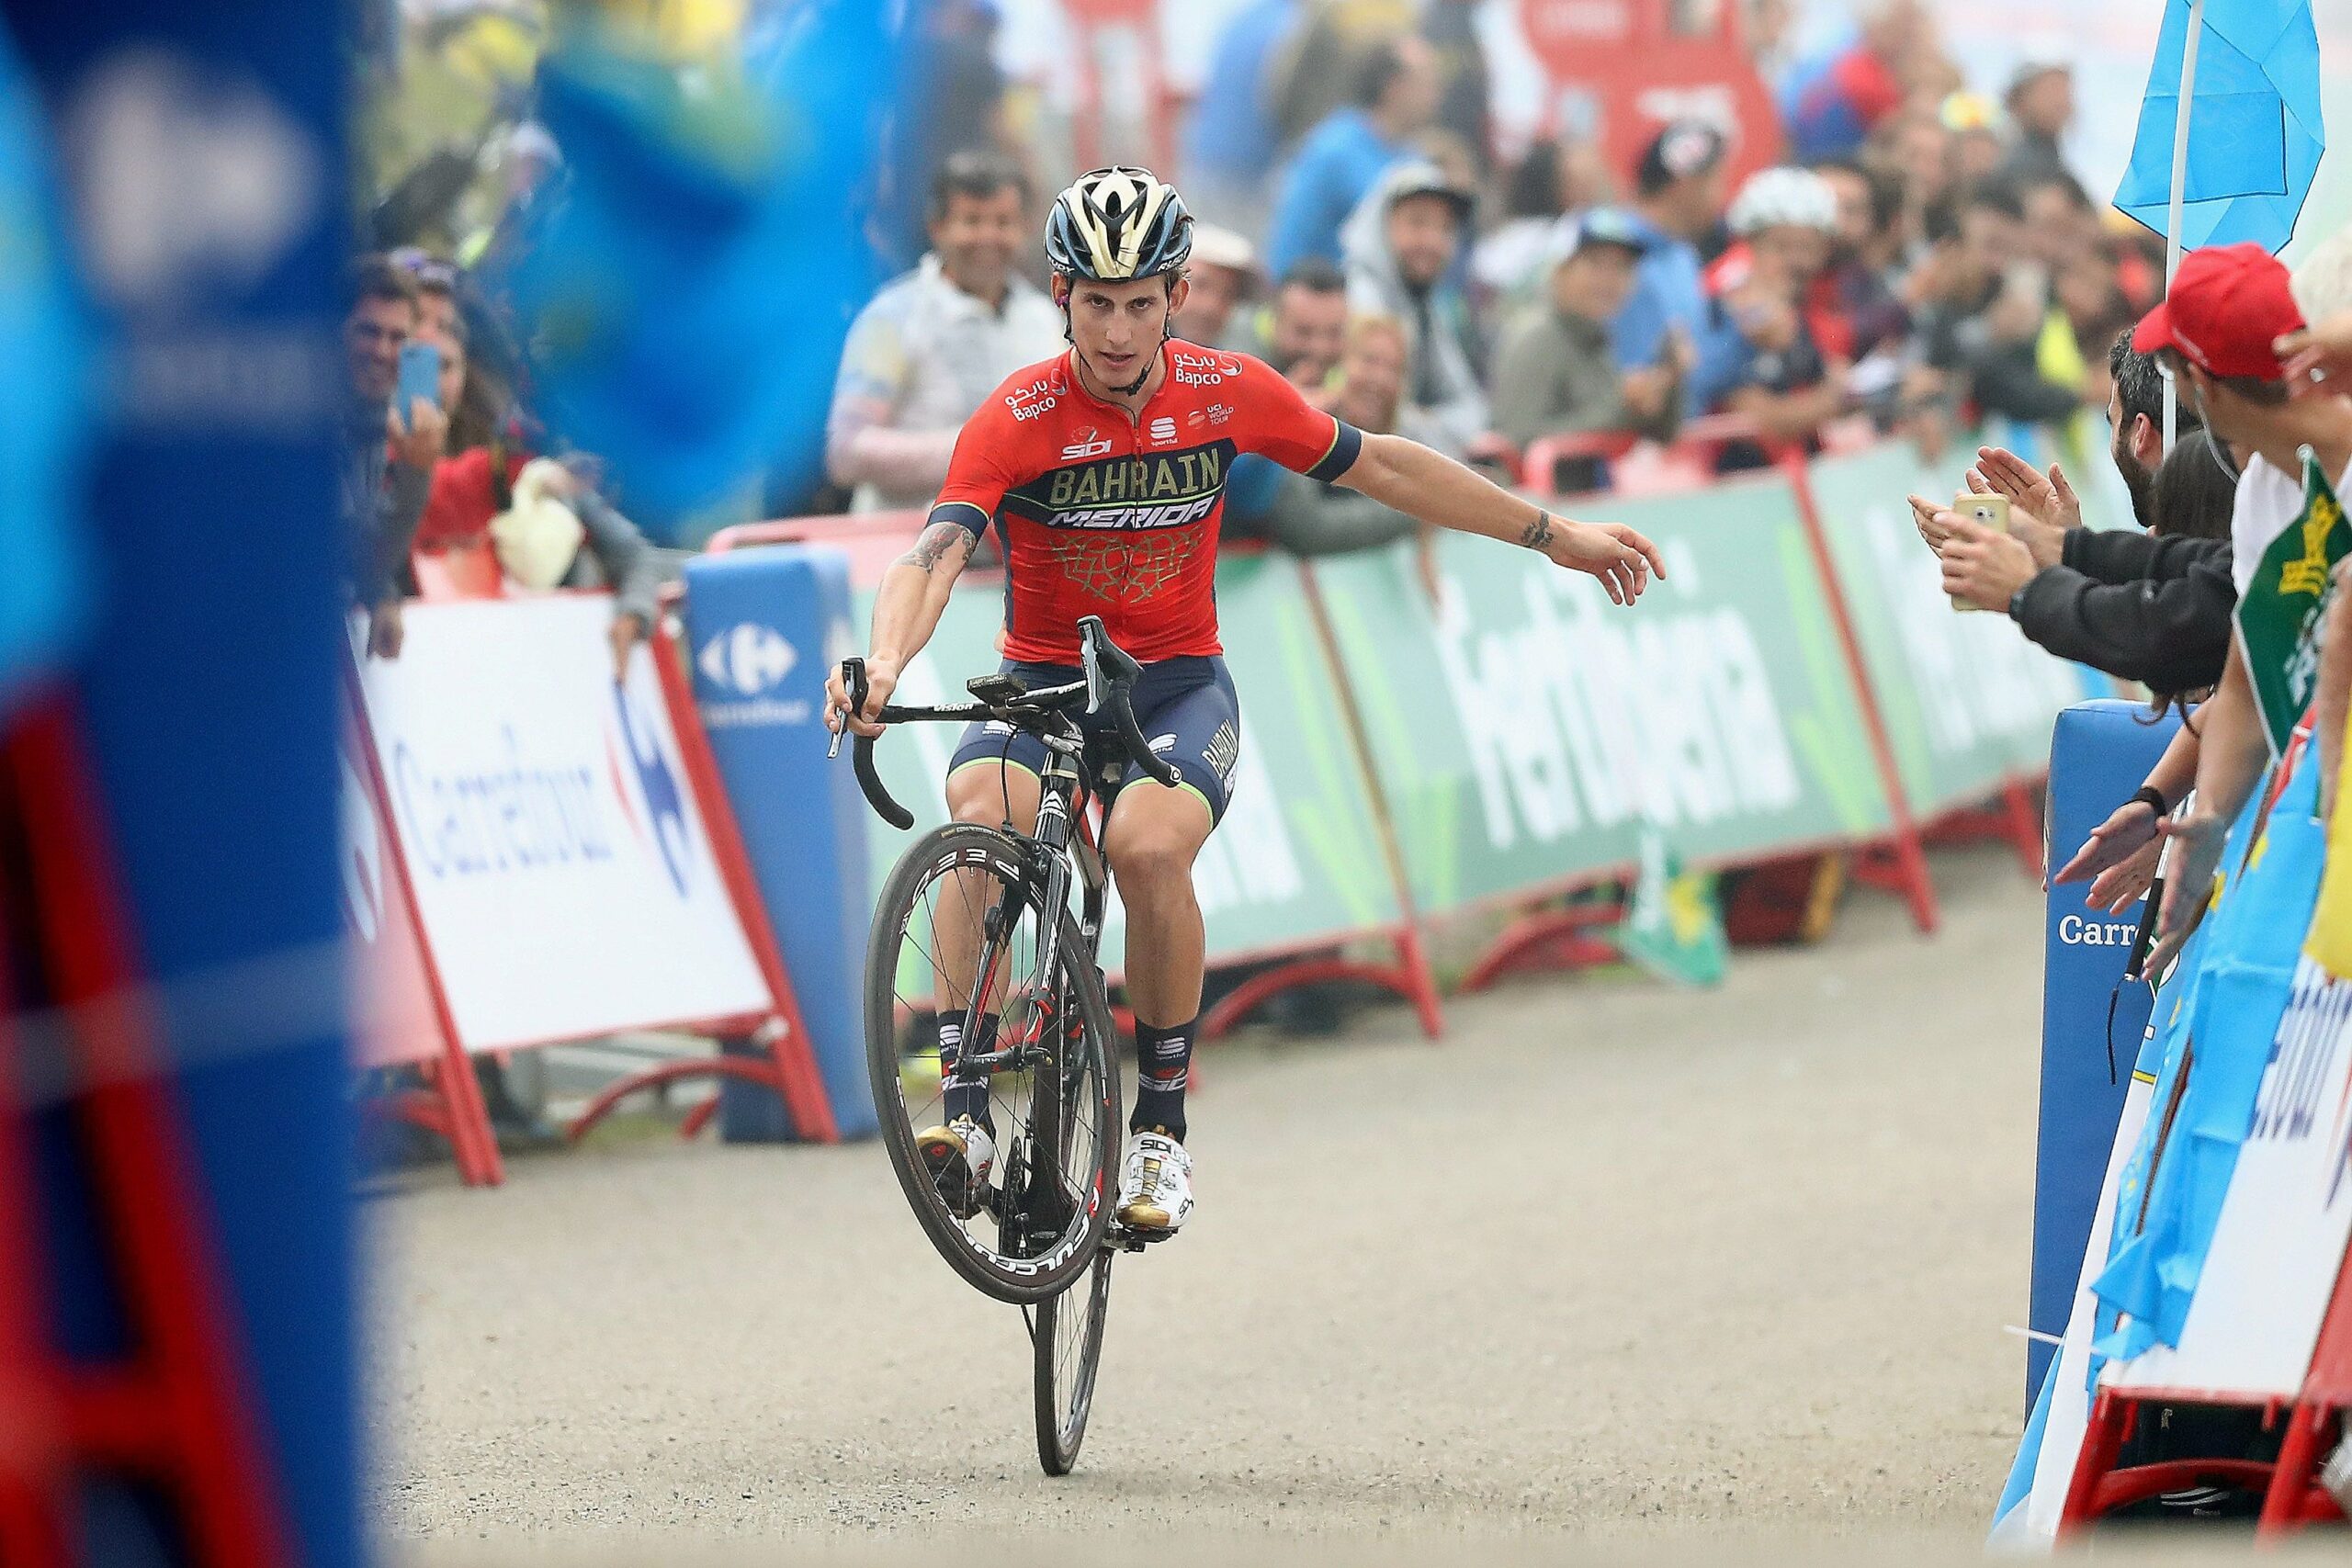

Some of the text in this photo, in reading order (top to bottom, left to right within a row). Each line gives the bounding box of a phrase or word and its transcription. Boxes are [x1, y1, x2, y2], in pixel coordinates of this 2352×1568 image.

[1174, 354, 1216, 370] بابكو
[1176, 368, 1221, 389] Bapco
[1012, 397, 1056, 422] Bapco
[1207, 404, 1222, 412] UCI
[1209, 407, 1234, 419] WORLD
[1049, 448, 1220, 504] BAHRAIN
[1047, 496, 1215, 528] MERIDA
[2059, 915, 2139, 945] Carr
